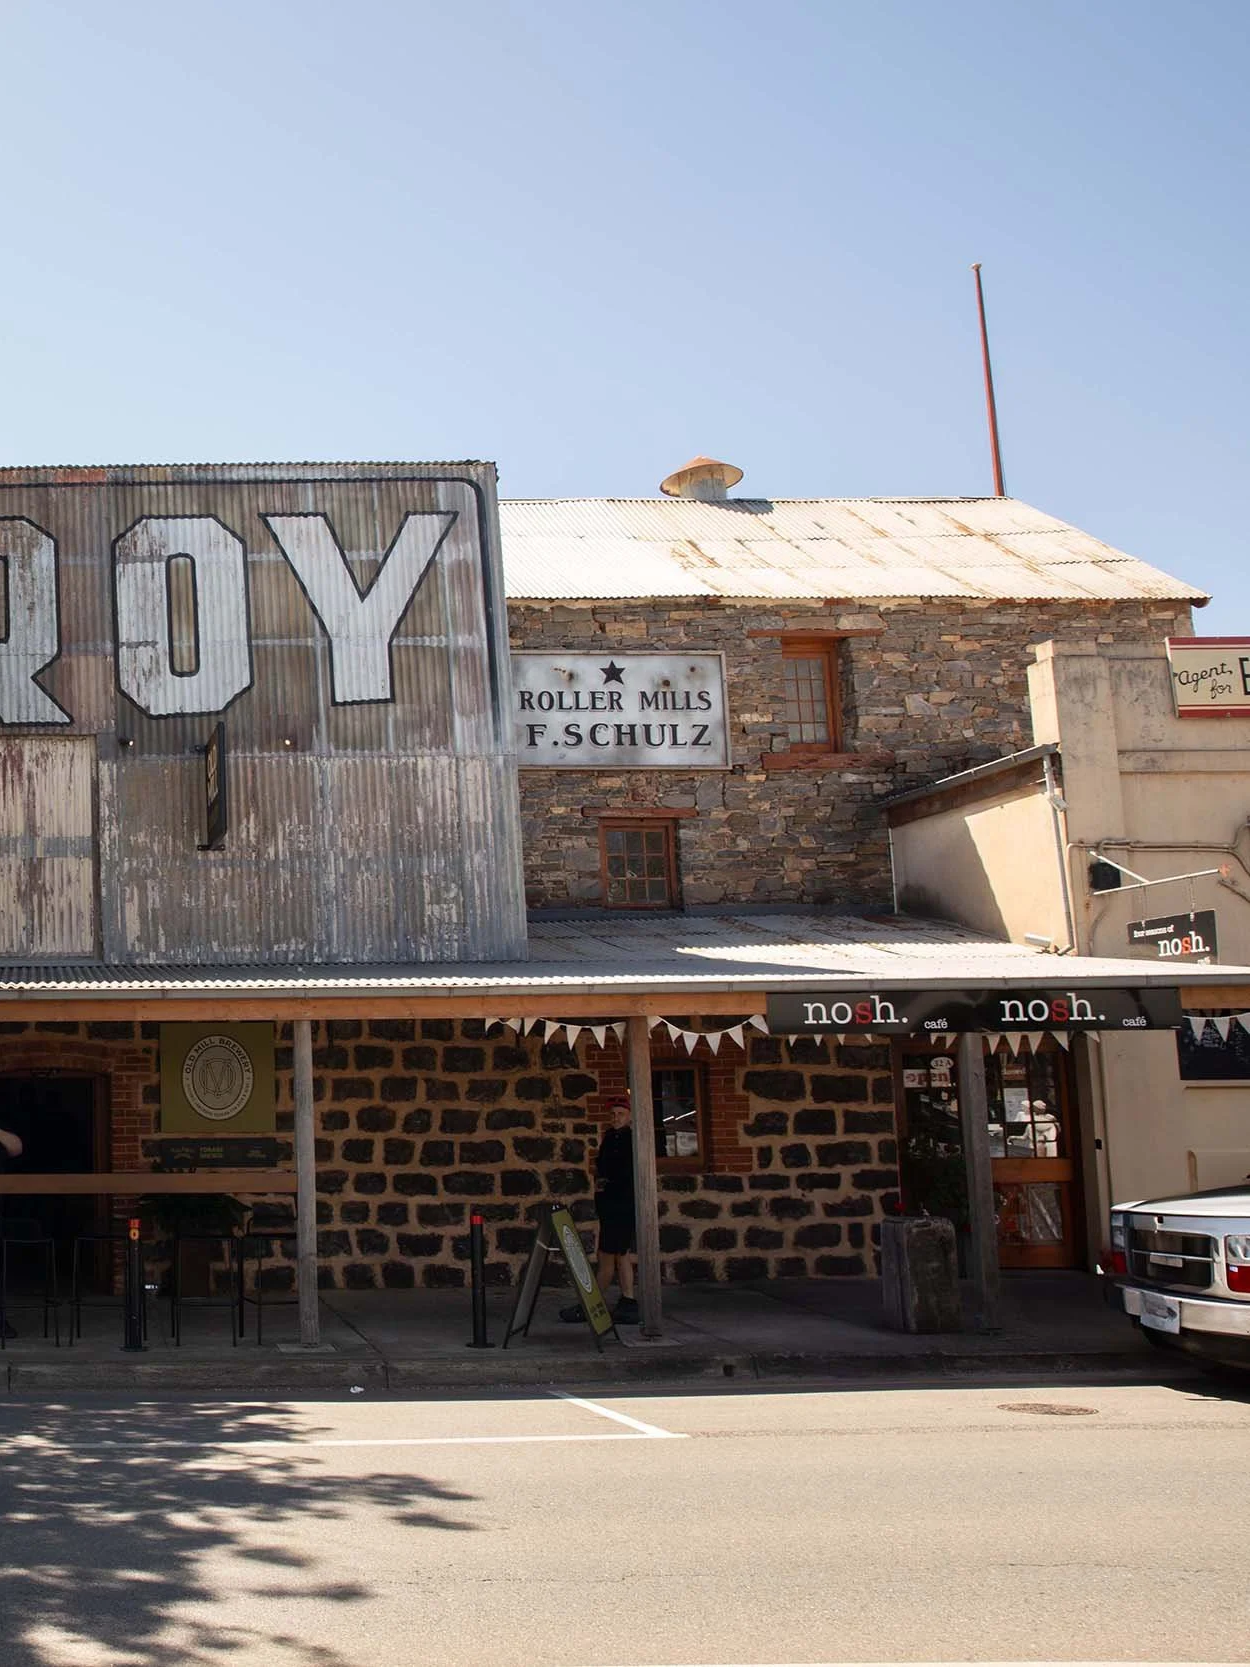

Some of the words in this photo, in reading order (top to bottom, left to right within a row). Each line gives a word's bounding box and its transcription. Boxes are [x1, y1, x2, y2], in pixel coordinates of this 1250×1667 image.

[1174, 662, 1233, 693] Agent
[1211, 679, 1233, 699] for
[519, 691, 623, 711] ROLLER
[639, 691, 712, 711] MILLS
[526, 723, 712, 748] F.SCHULZ
[1158, 931, 1210, 957] nosh.
[803, 995, 909, 1025] nosh.
[924, 1018, 948, 1029] café
[1000, 993, 1106, 1022] nosh.
[1122, 1016, 1147, 1027] café
[185, 1055, 196, 1074] OLD
[194, 1038, 216, 1054] MILL
[218, 1038, 252, 1073] BREWERY
